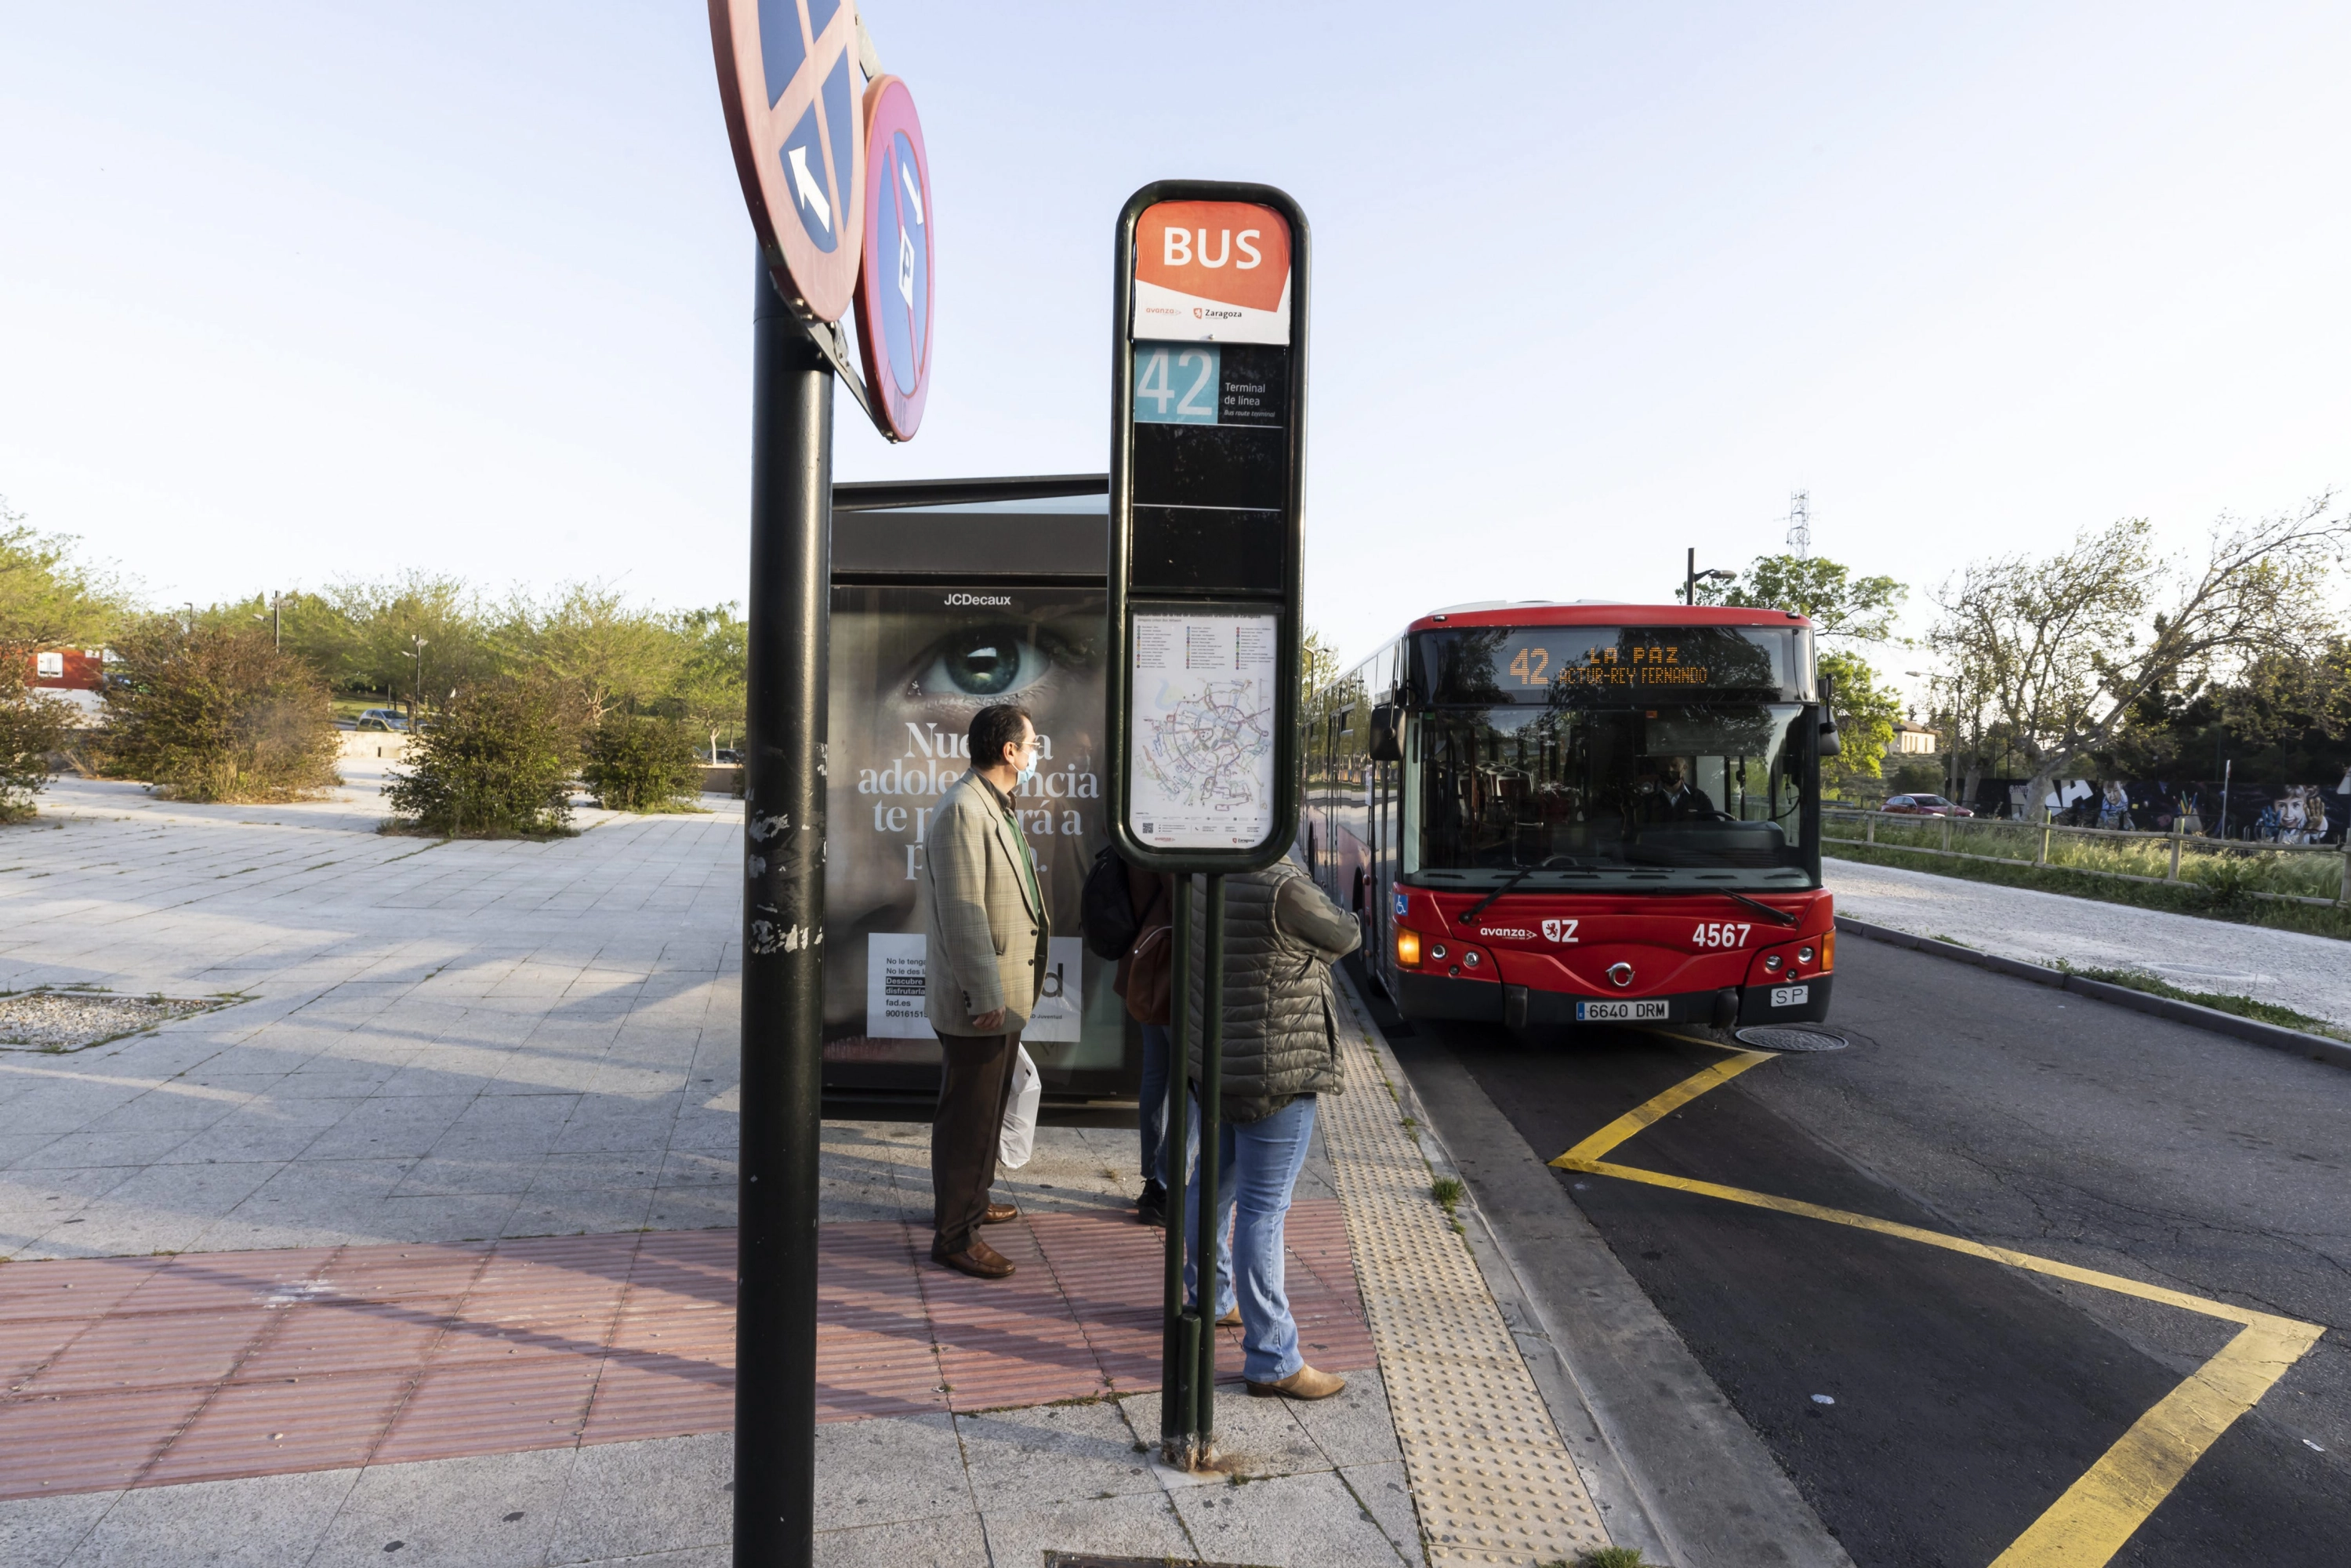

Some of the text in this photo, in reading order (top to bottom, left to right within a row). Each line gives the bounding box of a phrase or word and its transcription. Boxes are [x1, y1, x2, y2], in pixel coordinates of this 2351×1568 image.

[1164, 227, 1261, 269] BUS
[1205, 309, 1243, 319] Zaragoza
[1137, 347, 1213, 416] 42
[1224, 382, 1265, 394] Terminal
[1224, 395, 1261, 406] de línea
[944, 593, 1011, 605] JCDecaux
[1590, 647, 1678, 664] LA PAZ
[1510, 648, 1549, 684] 42
[1558, 666, 1707, 684] ACTUR-REY FERNANDO
[858, 759, 1100, 798] adolencia
[873, 799, 907, 832] te
[1061, 809, 1083, 835] a
[1480, 920, 1579, 942] avanza Z
[1693, 923, 1751, 947] 4567
[907, 958, 927, 967] tenga
[1589, 1004, 1628, 1018] 6640
[1636, 1003, 1665, 1018] DRM
